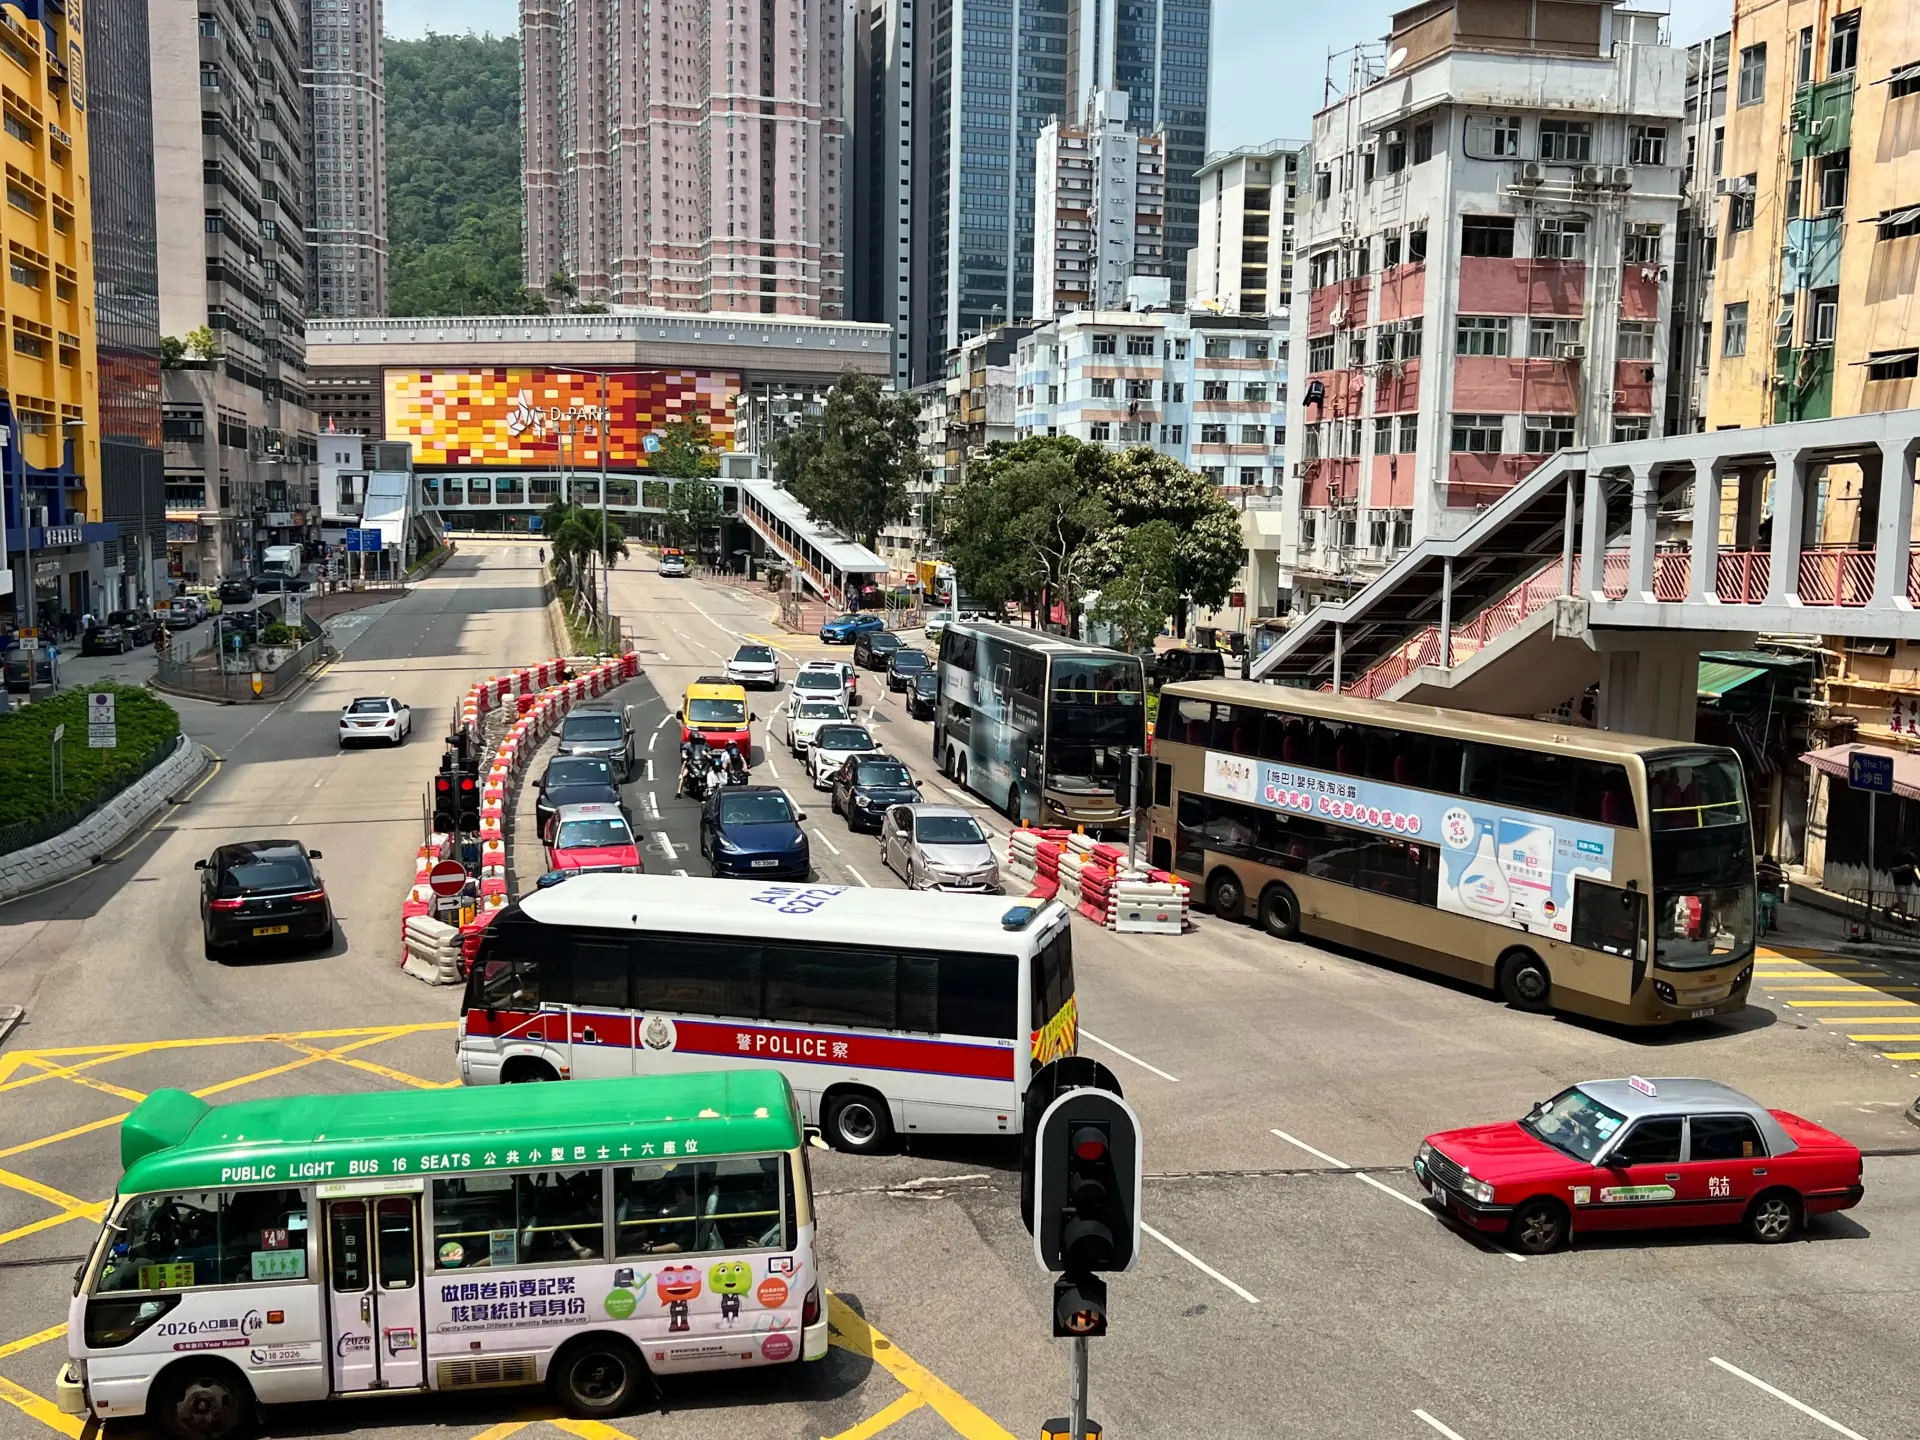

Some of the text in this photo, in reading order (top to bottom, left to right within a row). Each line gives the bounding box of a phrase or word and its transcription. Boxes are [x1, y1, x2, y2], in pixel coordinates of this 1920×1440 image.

[1862, 758, 1890, 771] Sha Tin
[1862, 771, 1883, 785] 沙田
[750, 887, 800, 905] AM
[778, 889, 842, 914] 6272
[736, 1033, 849, 1059] 警 POLICE 察
[221, 1138, 699, 1182] PUBLIC LIGHT BUS 16 SEATS 公共小型巴士十六座位
[1709, 1176, 1730, 1186] 的士
[1709, 1186, 1730, 1197] TAXI
[345, 1235, 358, 1280] 自動門
[441, 1276, 576, 1303] 做問卷前要記緊
[451, 1297, 586, 1323] 核實統計員身份
[157, 1322, 198, 1337] 2026
[204, 1340, 221, 1348] Year
[222, 1338, 246, 1347] Round
[345, 1336, 371, 1346] 2026
[268, 1350, 301, 1360] 18 2026
